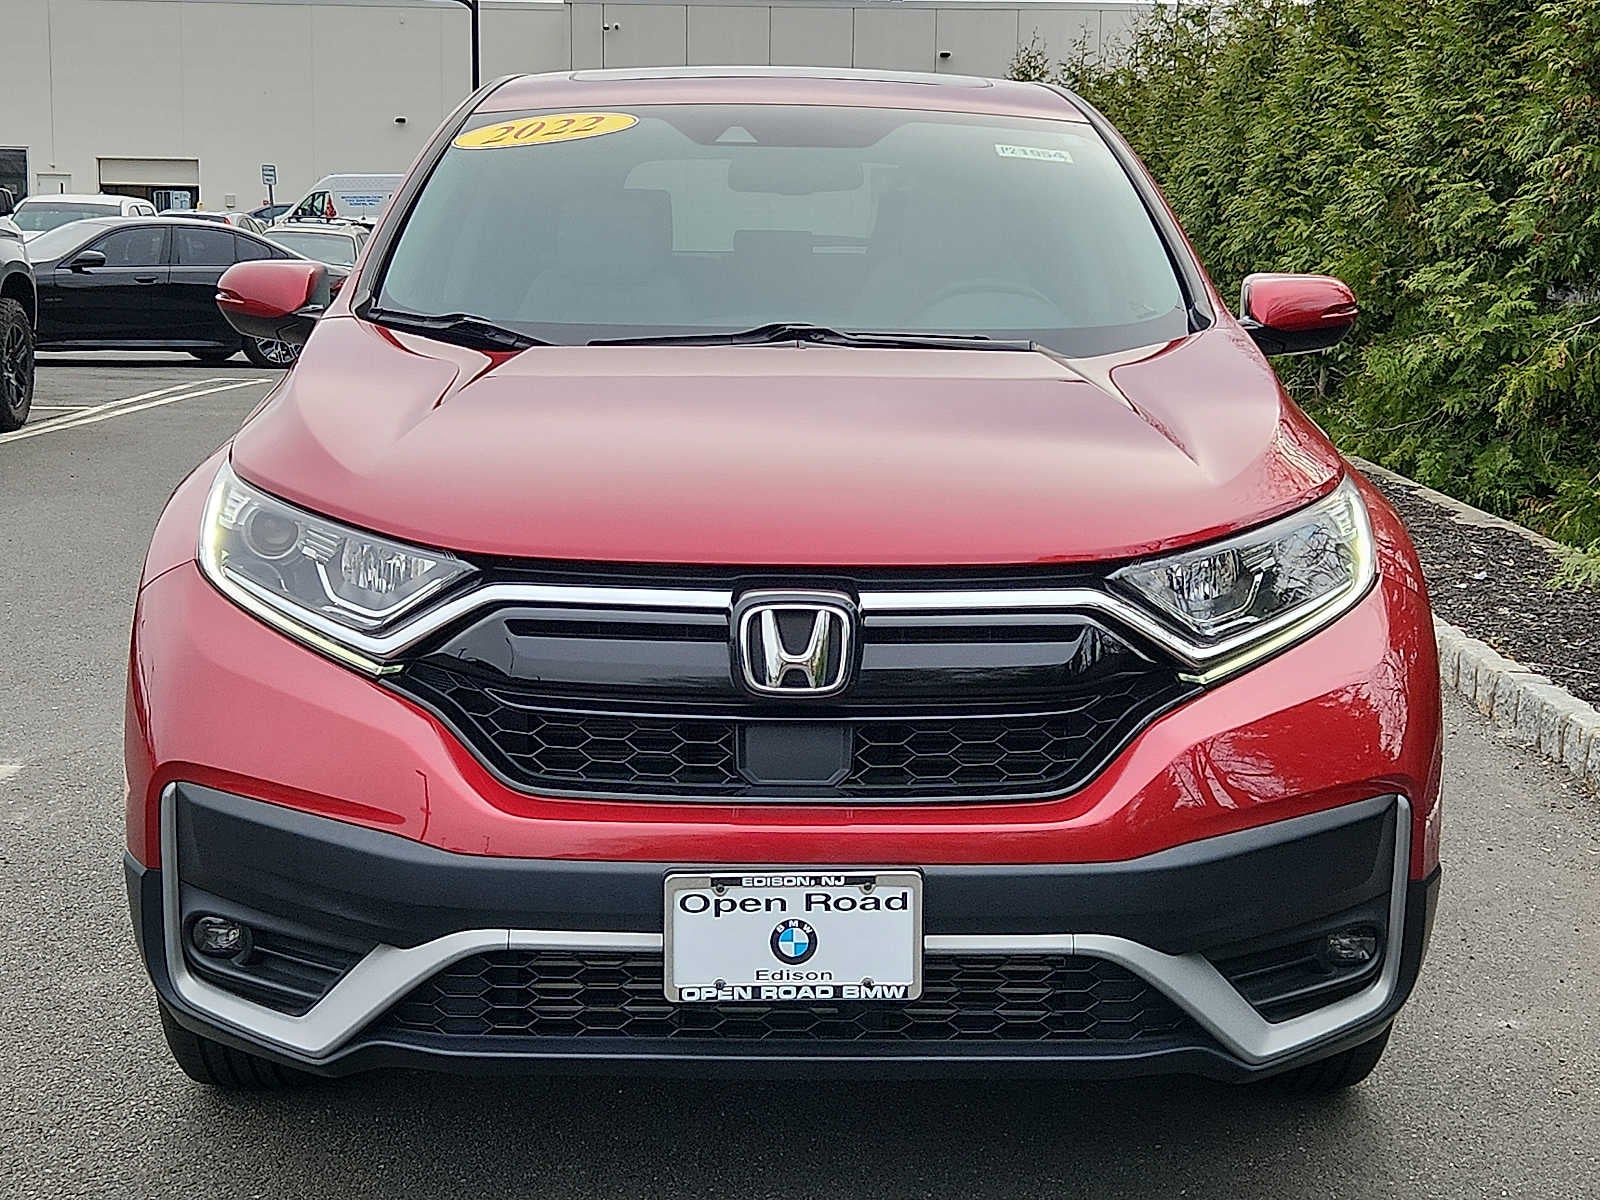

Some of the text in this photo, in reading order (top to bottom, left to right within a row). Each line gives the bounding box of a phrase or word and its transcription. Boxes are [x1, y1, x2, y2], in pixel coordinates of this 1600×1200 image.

[480, 116, 605, 145] 2022
[741, 876, 846, 888] EDISON, NJ
[679, 892, 908, 917] Open Road
[776, 919, 813, 933] BMW
[755, 969, 833, 981] Edison
[681, 986, 906, 1000] OPEN ROAD BMW
